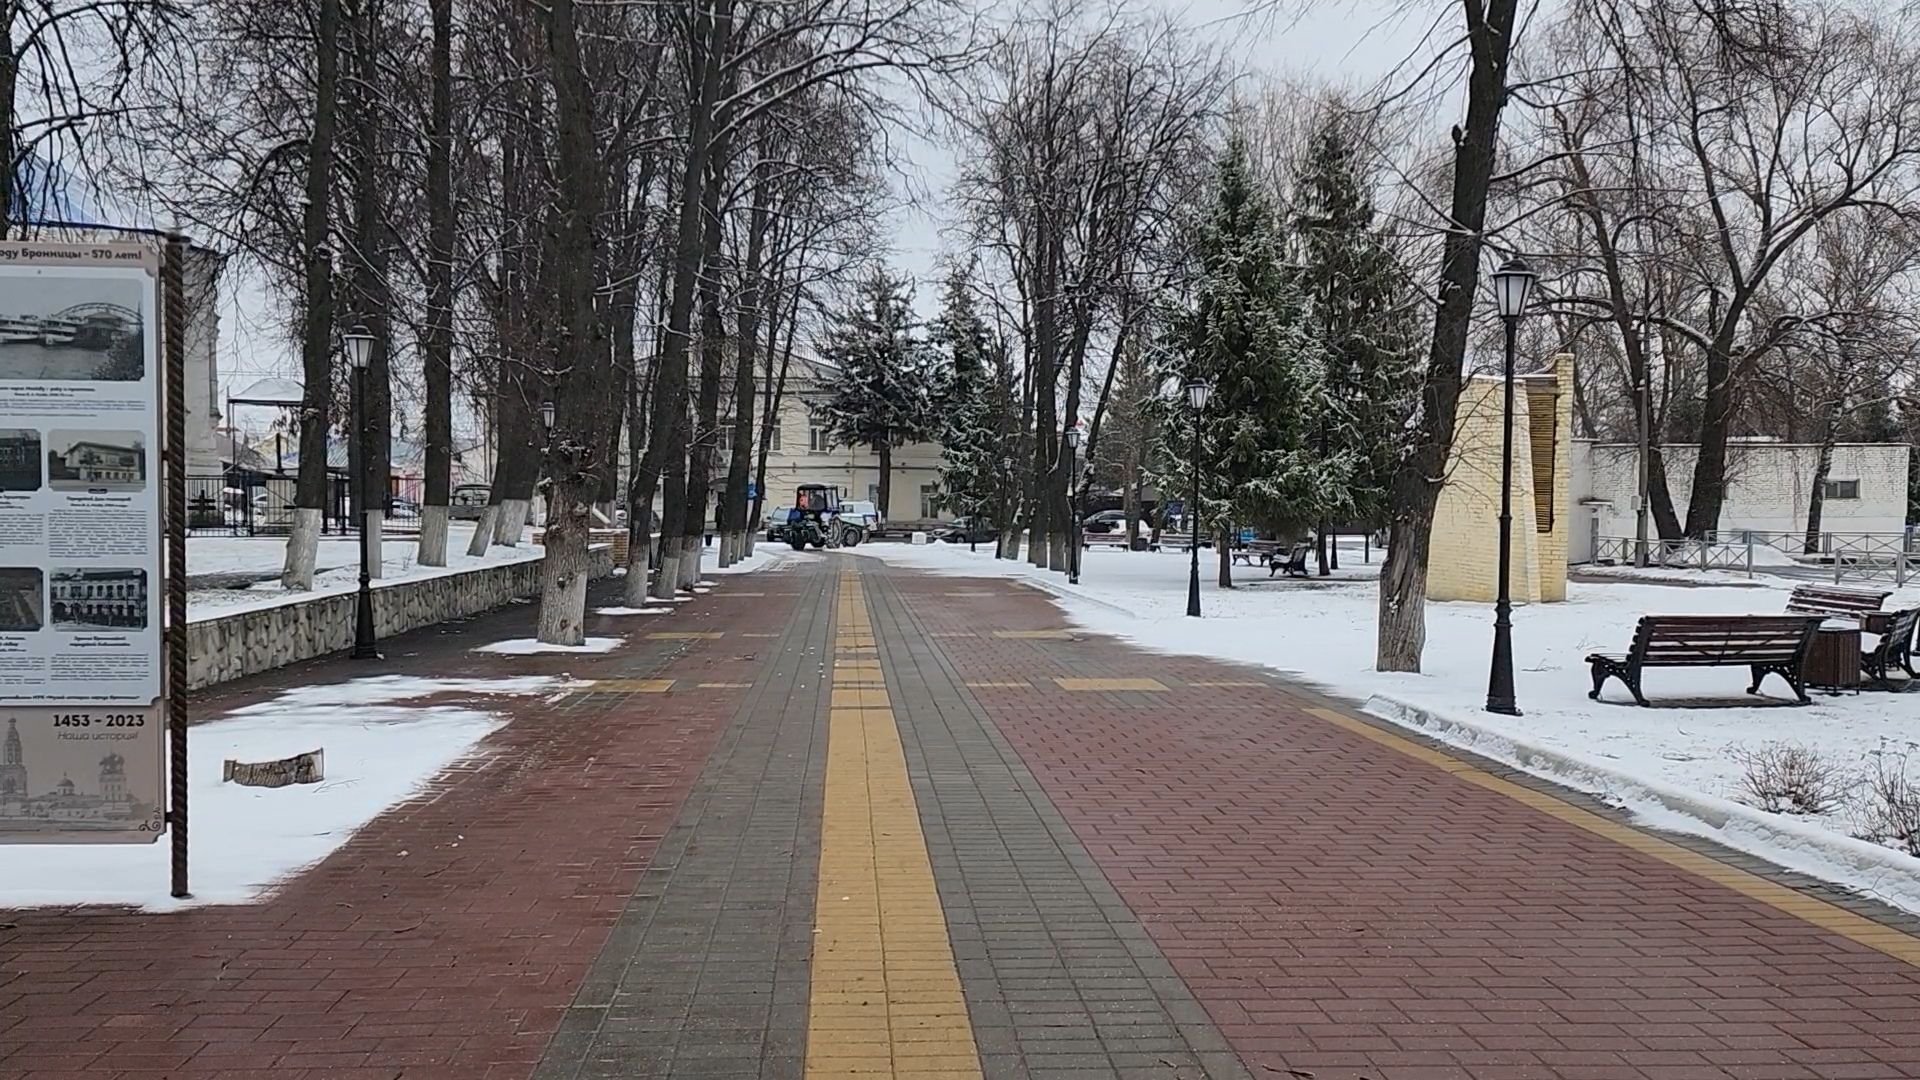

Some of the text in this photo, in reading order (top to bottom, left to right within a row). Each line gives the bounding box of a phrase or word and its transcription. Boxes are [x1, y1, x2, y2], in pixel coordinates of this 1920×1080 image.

[21, 248, 81, 260] Бронницы
[91, 249, 112, 260] 570
[114, 250, 142, 260] лет!
[53, 714, 90, 727] 1453
[106, 714, 145, 728] 2023
[57, 731, 139, 742] Наша история!
